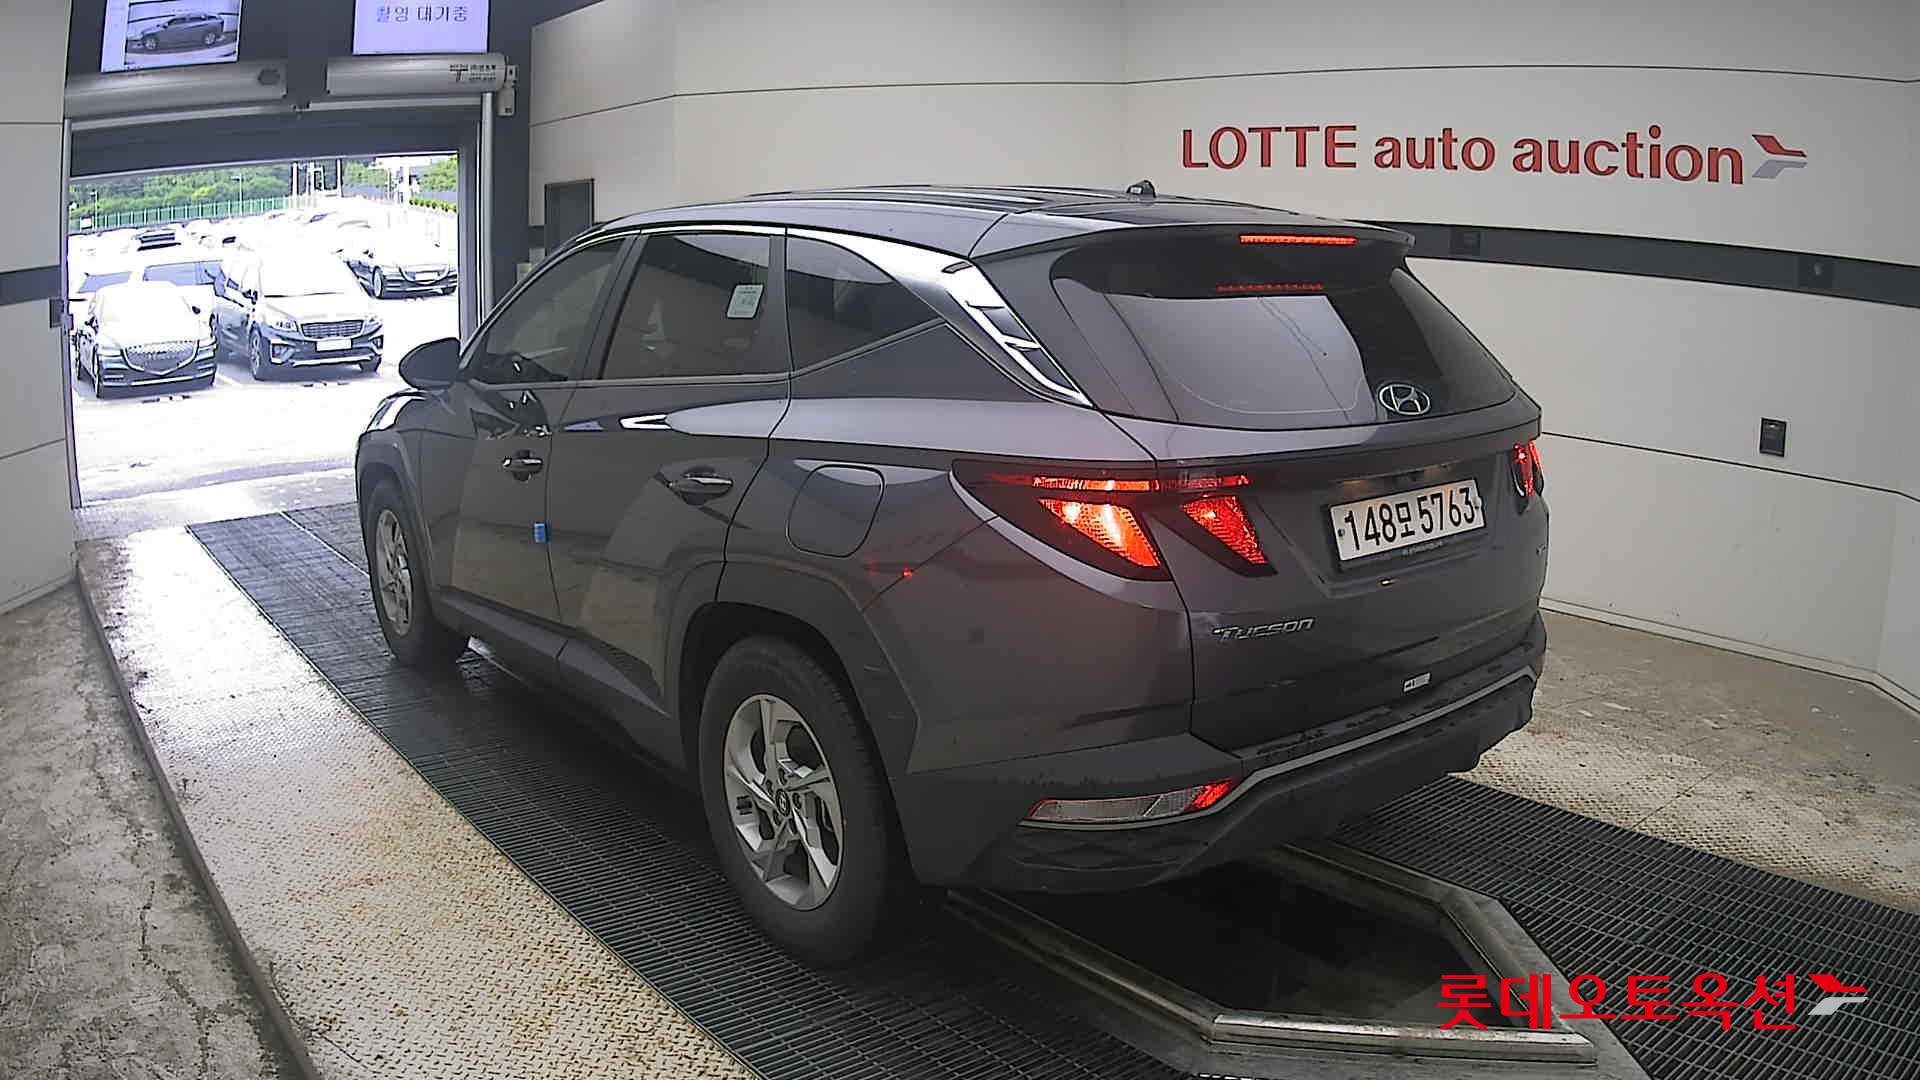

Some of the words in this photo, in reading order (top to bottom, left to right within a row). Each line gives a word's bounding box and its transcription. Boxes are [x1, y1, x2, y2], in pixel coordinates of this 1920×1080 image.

[417, 4, 468, 23] 대기중
[1181, 124, 1358, 169] LOTTE
[1373, 127, 1496, 172] auto
[1512, 124, 1744, 185] auction
